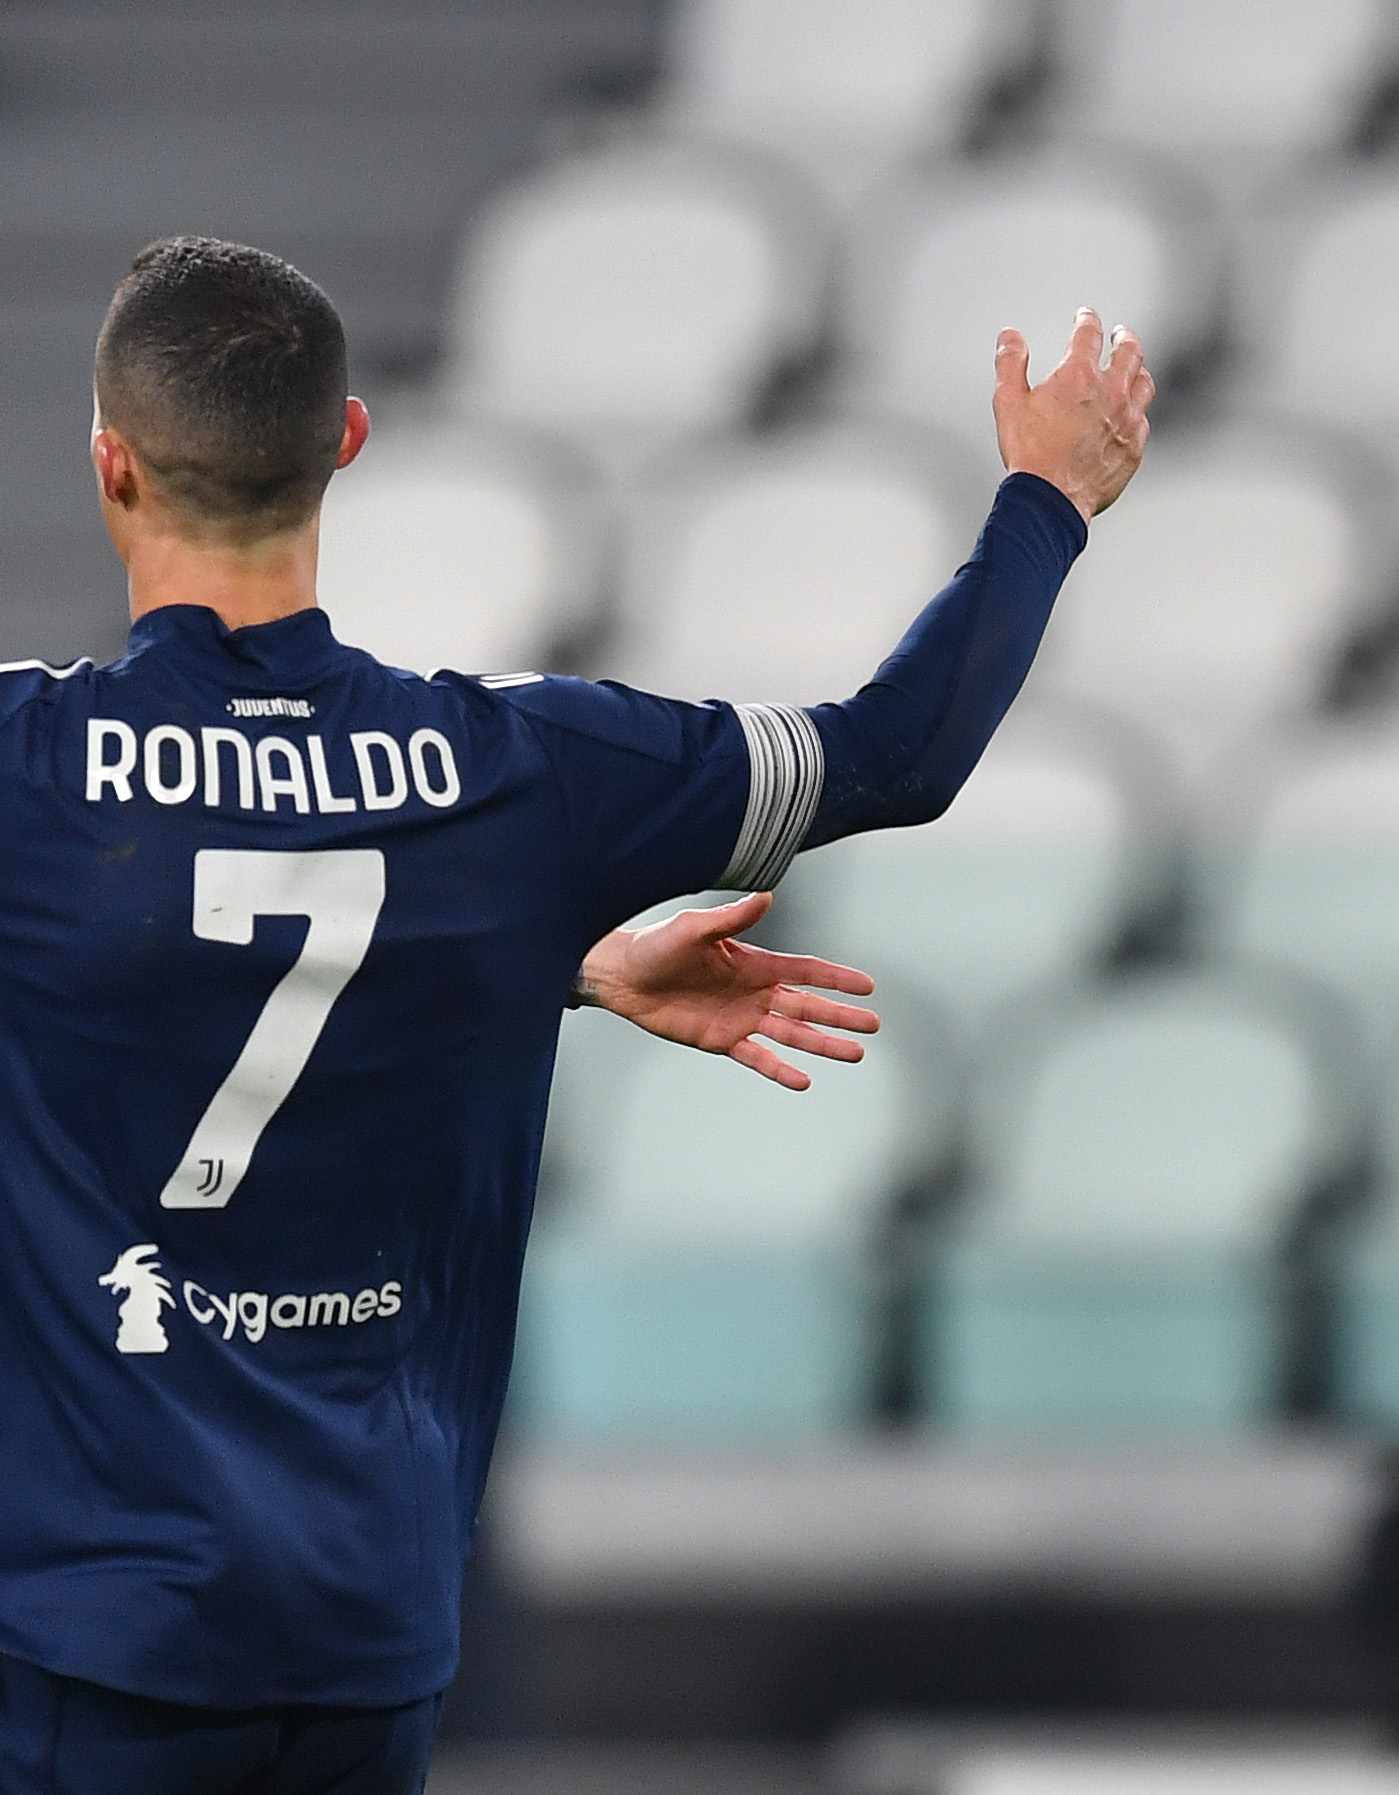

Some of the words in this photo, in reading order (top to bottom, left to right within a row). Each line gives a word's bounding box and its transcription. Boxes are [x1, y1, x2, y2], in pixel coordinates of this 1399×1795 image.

[86, 718, 461, 814] RONALDO
[160, 848, 386, 1209] 7
[183, 1279, 402, 1343] Cygames
